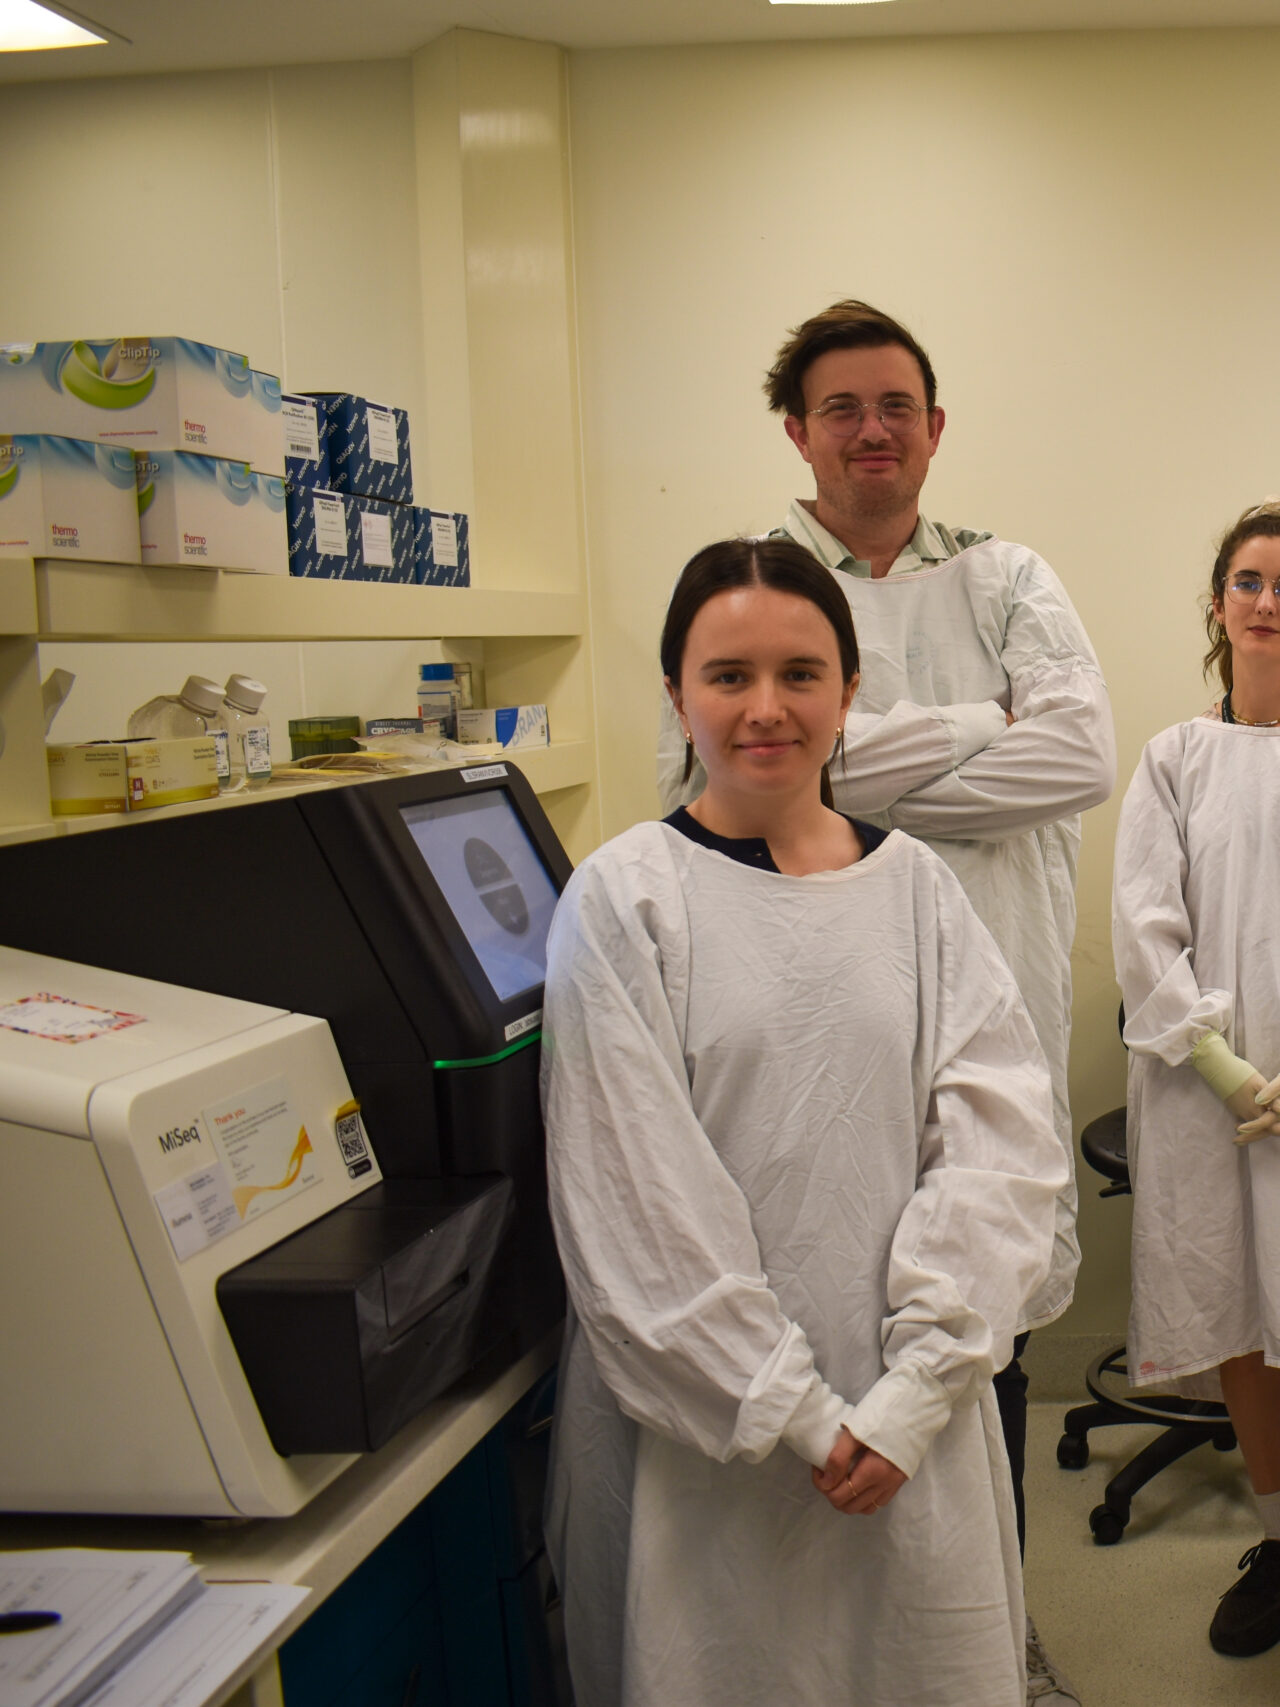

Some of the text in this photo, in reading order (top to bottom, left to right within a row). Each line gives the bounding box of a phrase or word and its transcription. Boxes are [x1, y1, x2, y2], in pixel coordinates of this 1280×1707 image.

[119, 347, 160, 359] ClipTip
[184, 421, 206, 433] thermo
[184, 433, 208, 444] scientific
[0, 446, 23, 457] pTip
[336, 441, 355, 465] QIAGEN
[52, 524, 78, 536] thermo
[53, 537, 80, 548] scientific
[184, 532, 207, 544] thermo
[184, 545, 208, 556] scientific
[512, 704, 546, 746] BRAN
[214, 1108, 246, 1126] Thank you
